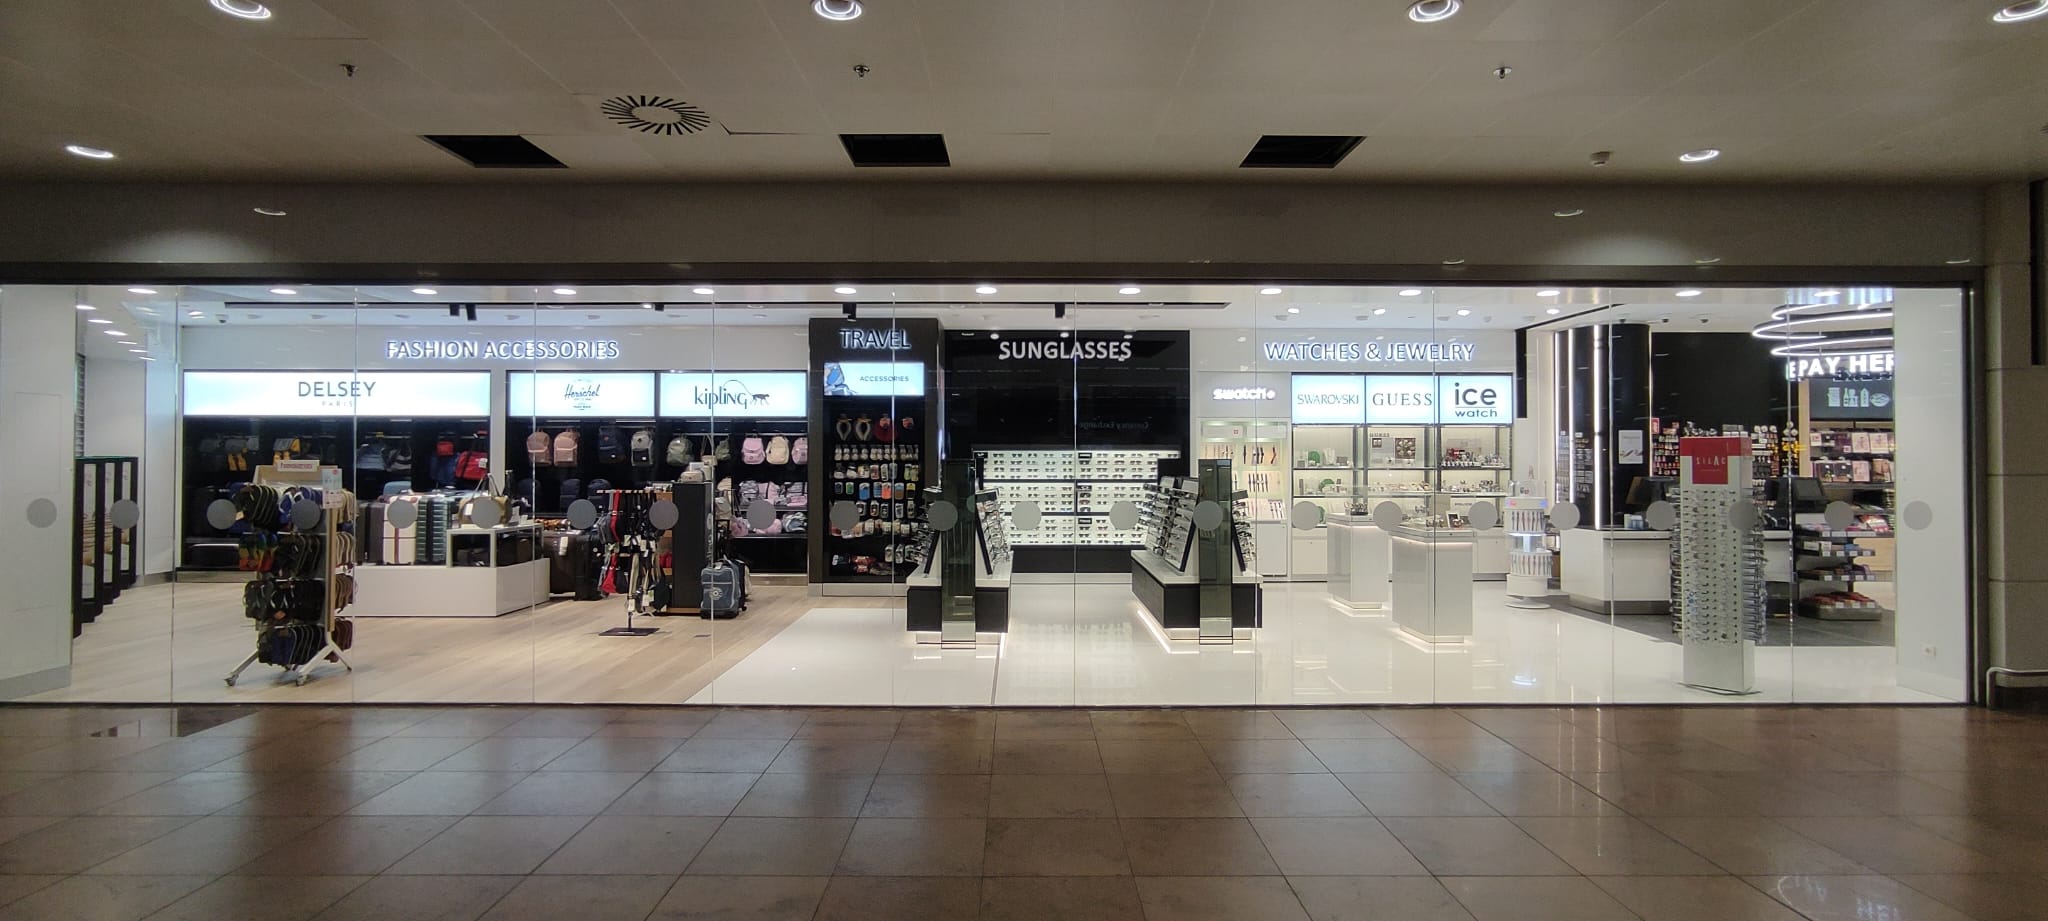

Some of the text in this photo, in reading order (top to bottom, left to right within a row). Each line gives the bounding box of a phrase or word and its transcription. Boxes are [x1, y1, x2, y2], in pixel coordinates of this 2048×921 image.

[839, 328, 912, 349] TRAVEL
[386, 340, 619, 359] FASHION ACCESSORIES
[999, 341, 1132, 360] SUNGLASSES
[1264, 341, 1475, 361] WATCHES & JEWELRY
[1799, 357, 1841, 377] PAY
[298, 381, 376, 397] DELSEY
[564, 384, 601, 400] Herschel
[695, 385, 748, 409] kipling
[1454, 382, 1497, 406] ice
[1297, 393, 1359, 405] SWAROVSKI
[1372, 392, 1433, 406] GUESS
[1455, 408, 1498, 418] watch
